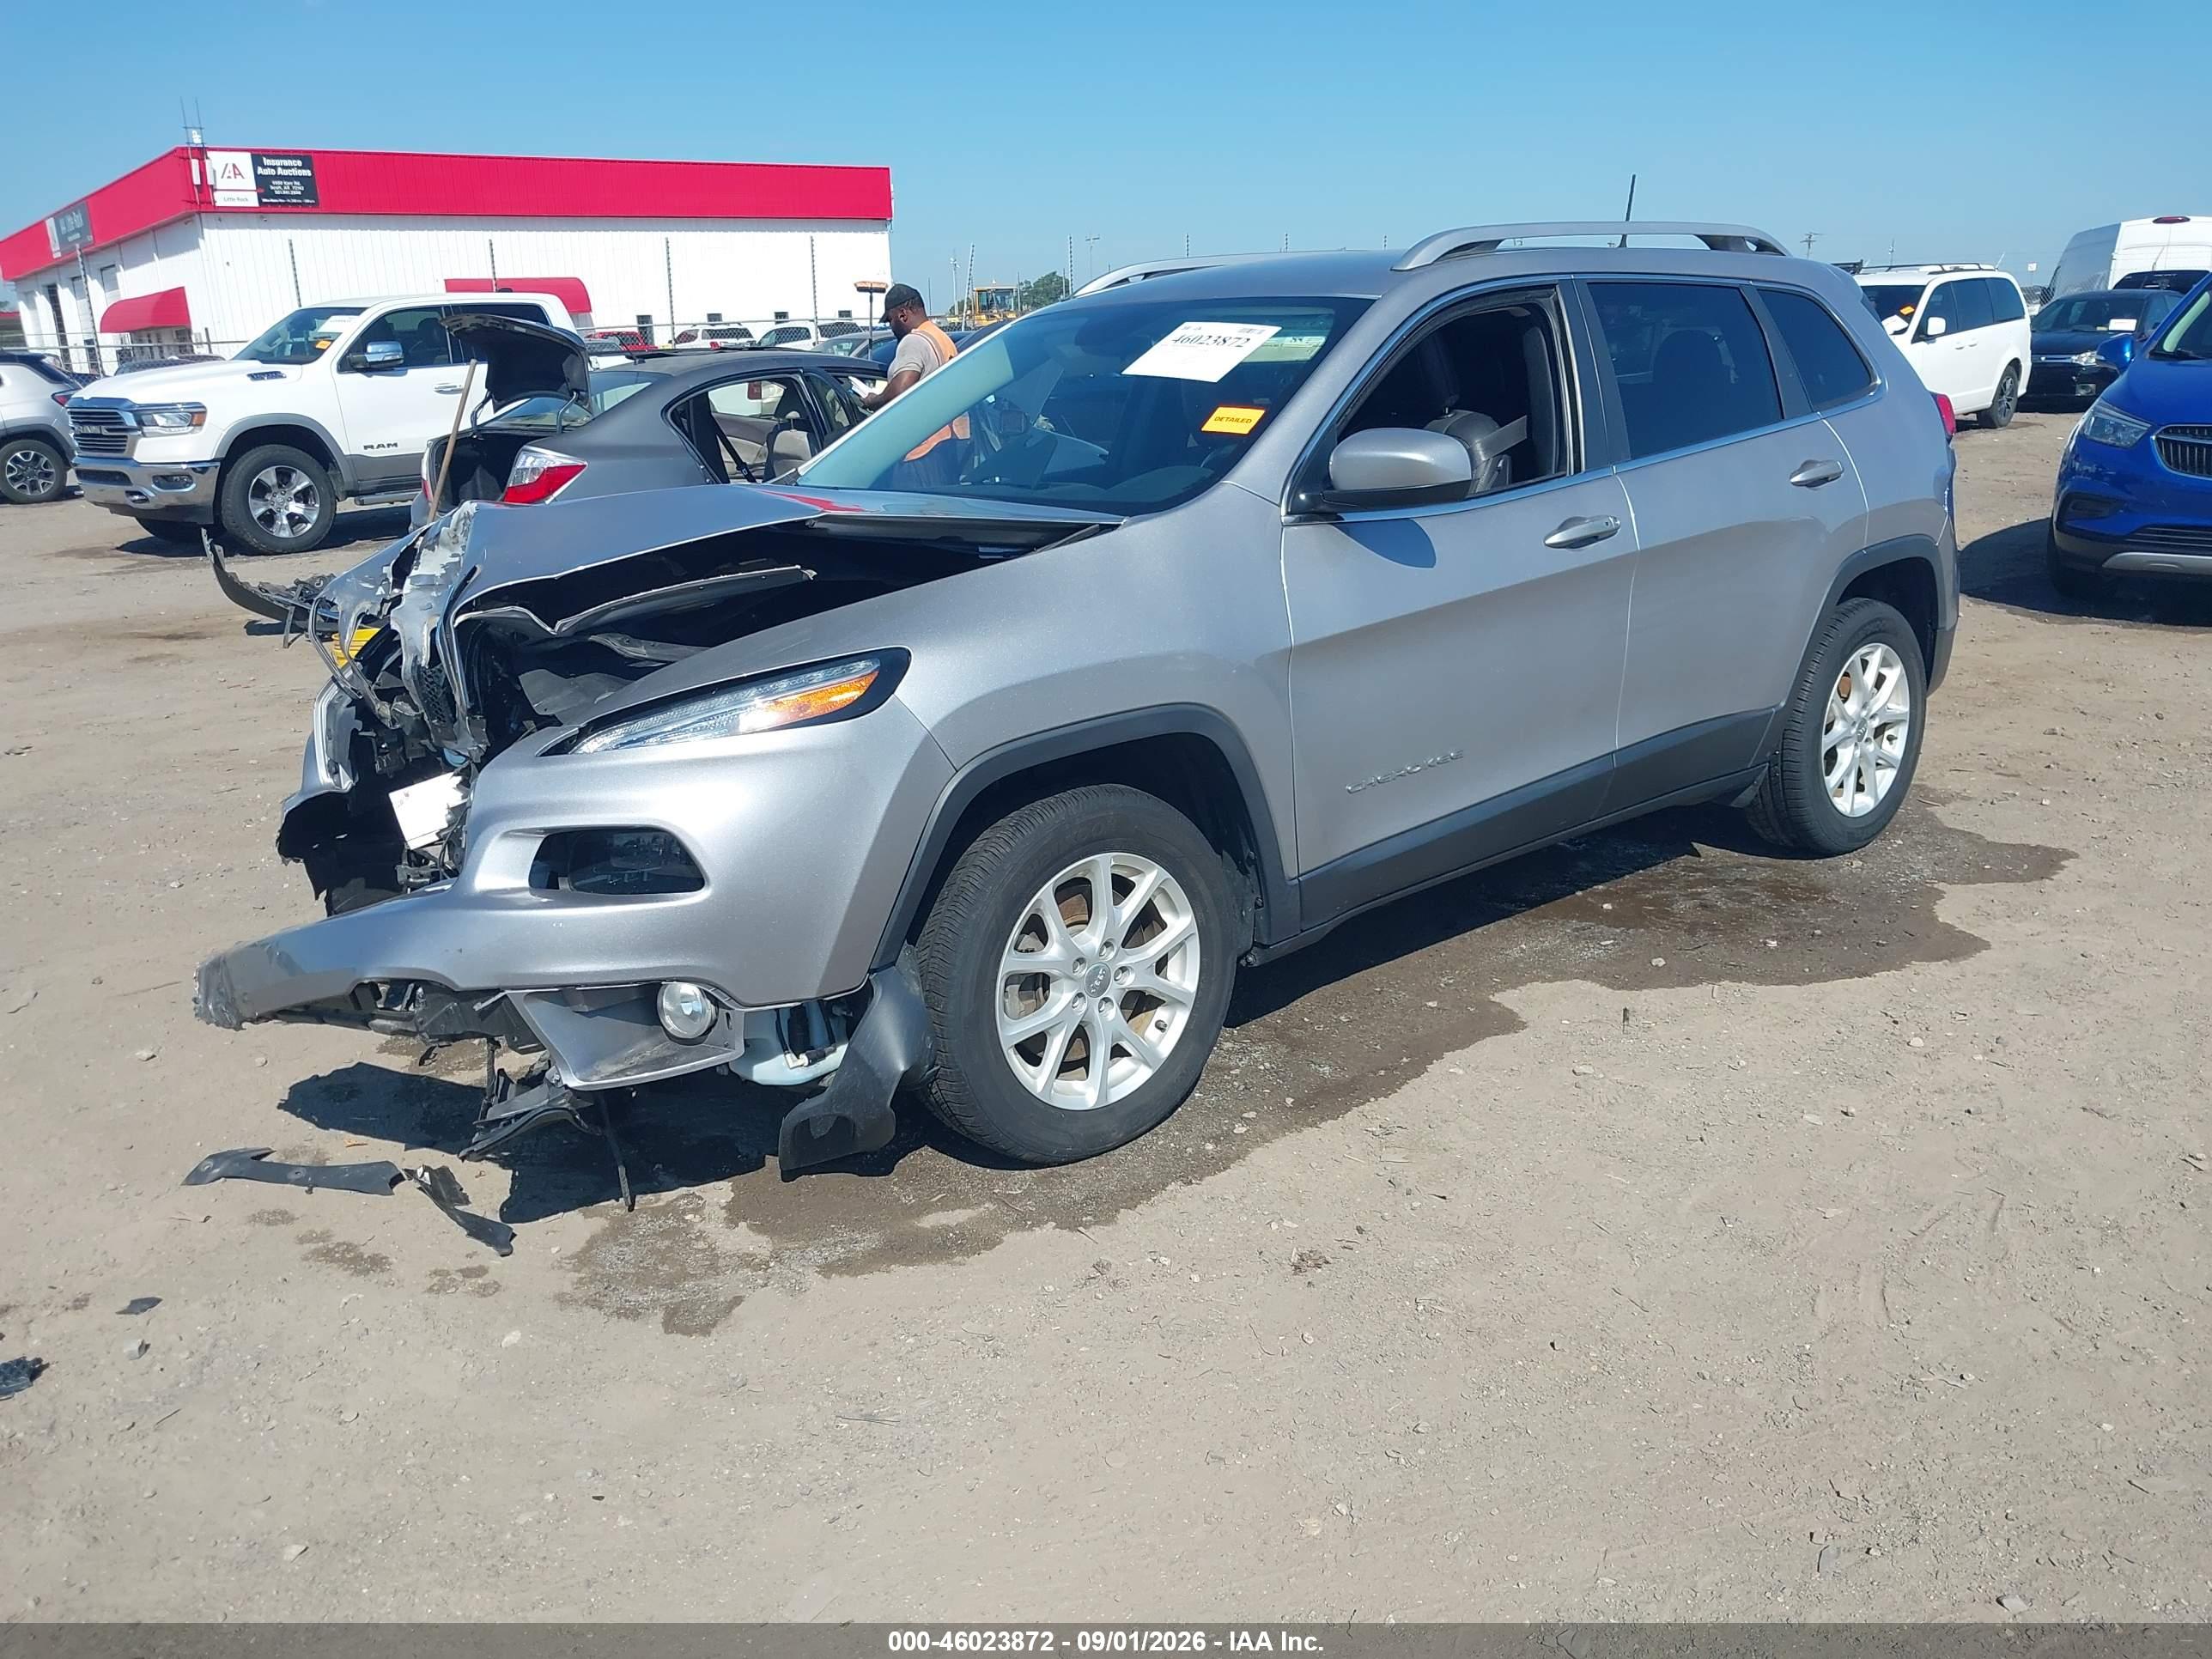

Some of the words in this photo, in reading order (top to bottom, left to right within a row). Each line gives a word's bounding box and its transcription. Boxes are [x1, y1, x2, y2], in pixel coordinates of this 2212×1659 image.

[262, 156, 302, 167] Insurance
[258, 166, 276, 175] Auto
[277, 167, 312, 177] Auctions
[1171, 333, 1251, 348] 46023872
[1214, 416, 1253, 424] DETAILED
[1346, 750, 1464, 794] CHEROKEE
